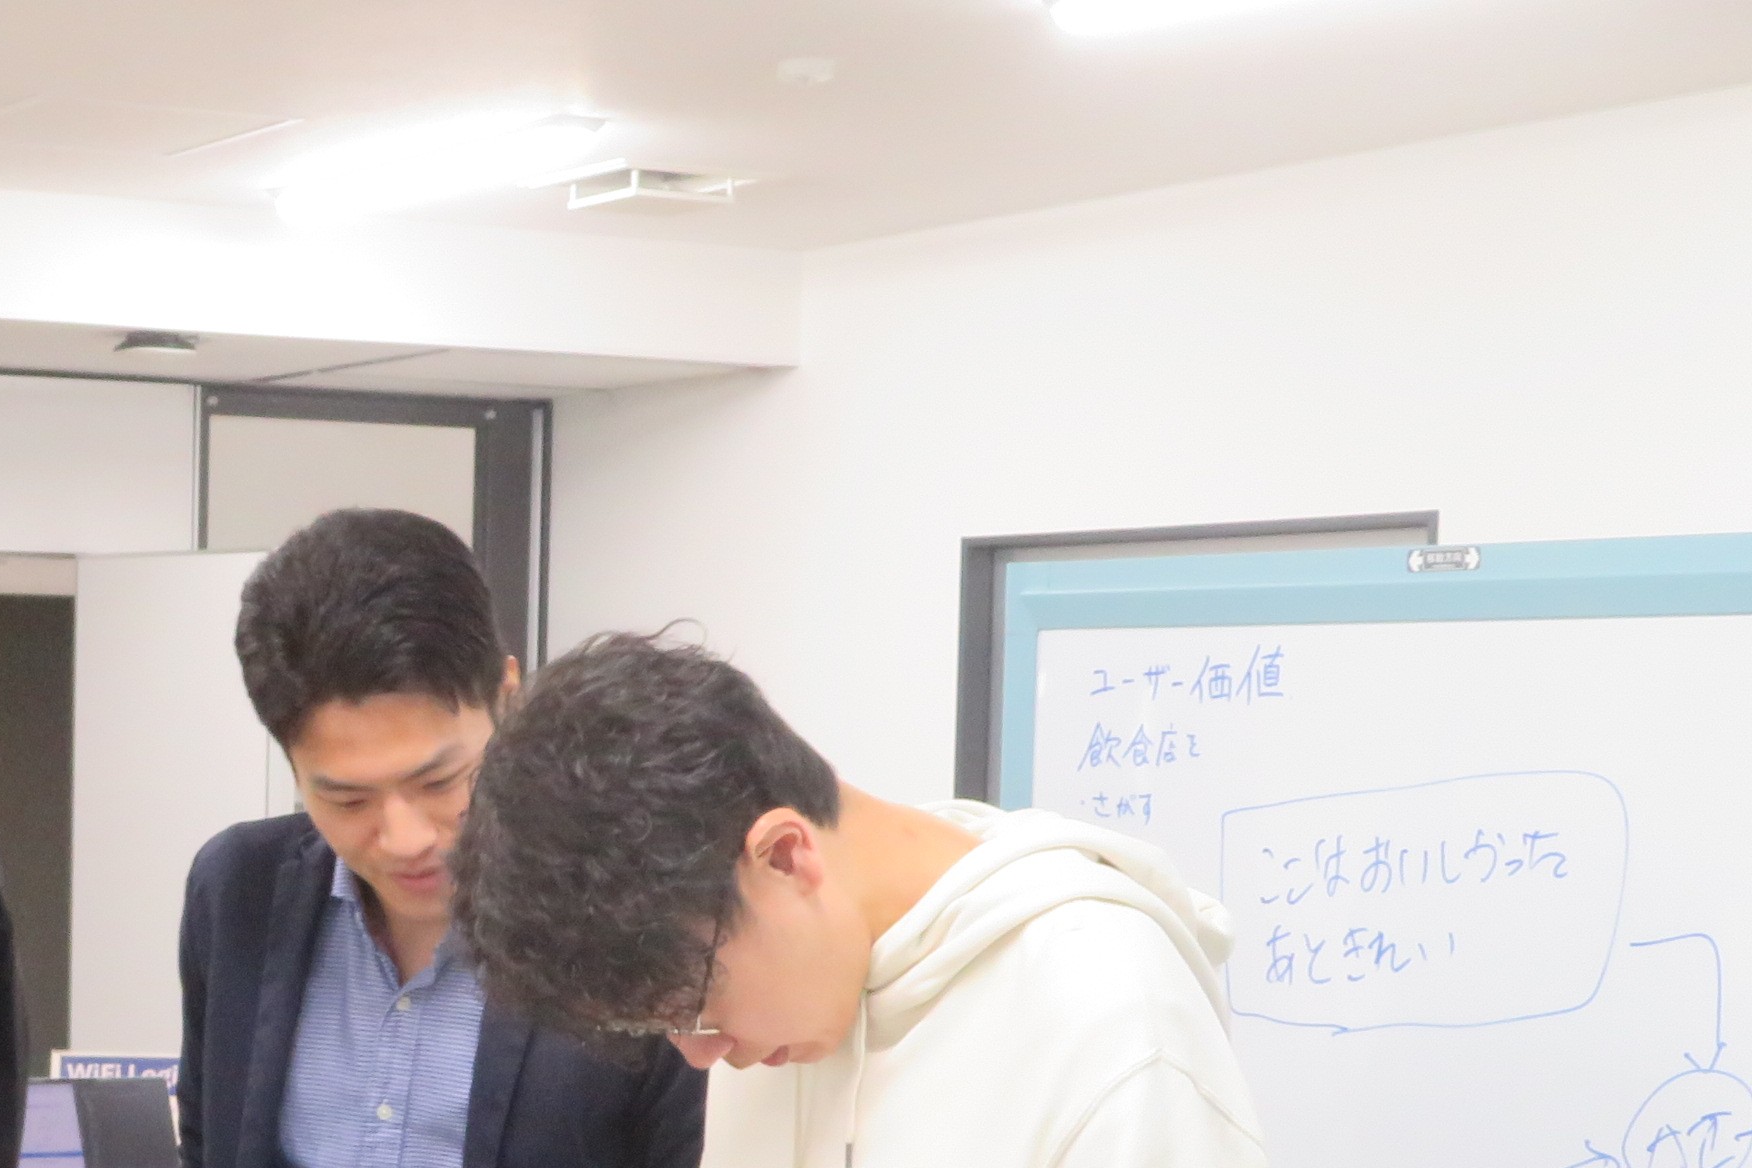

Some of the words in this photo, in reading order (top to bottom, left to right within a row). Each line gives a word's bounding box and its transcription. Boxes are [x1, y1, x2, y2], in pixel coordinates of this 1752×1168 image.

[1089, 644, 1285, 705] ユーザー価値
[1259, 828, 1568, 905] ここはおいしかった
